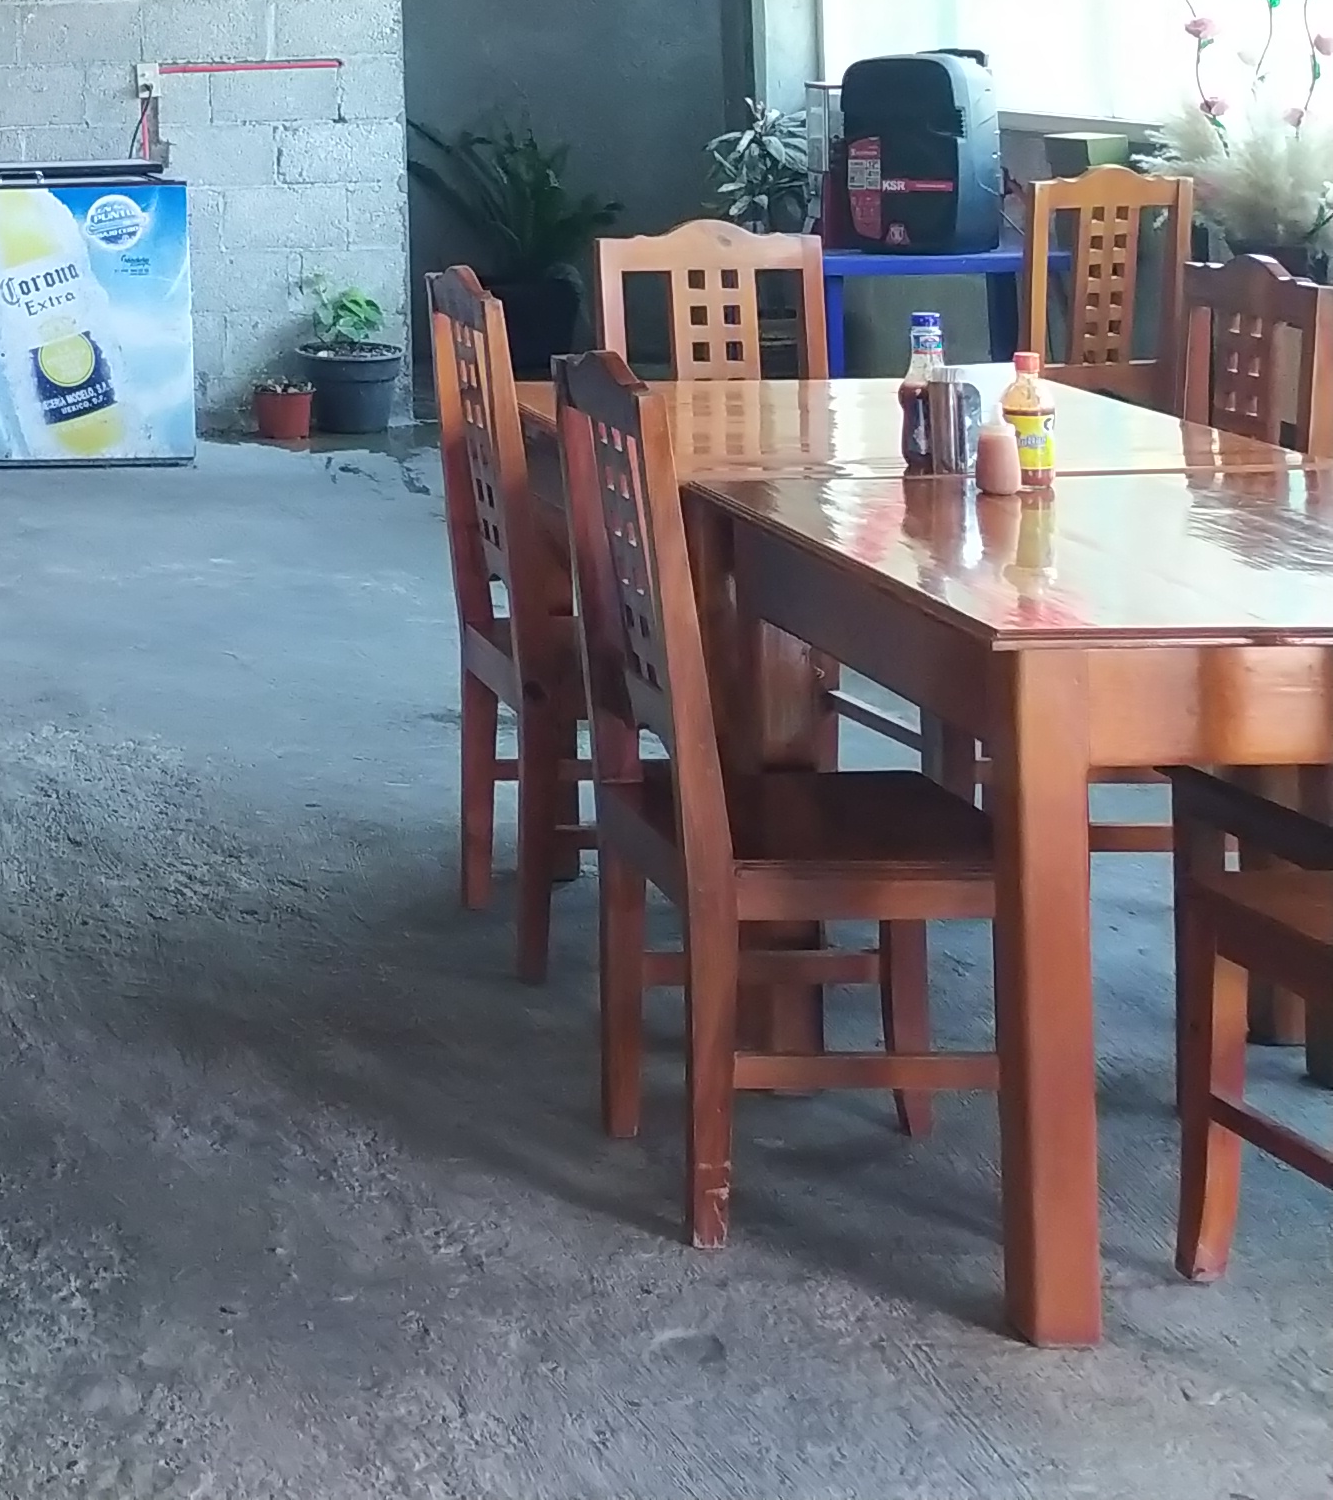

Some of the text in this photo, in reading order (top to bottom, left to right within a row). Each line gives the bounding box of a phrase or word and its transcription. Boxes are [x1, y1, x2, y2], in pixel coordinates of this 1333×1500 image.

[882, 180, 906, 192] KSR
[0, 263, 80, 308] Corona
[24, 291, 76, 317] Extra
